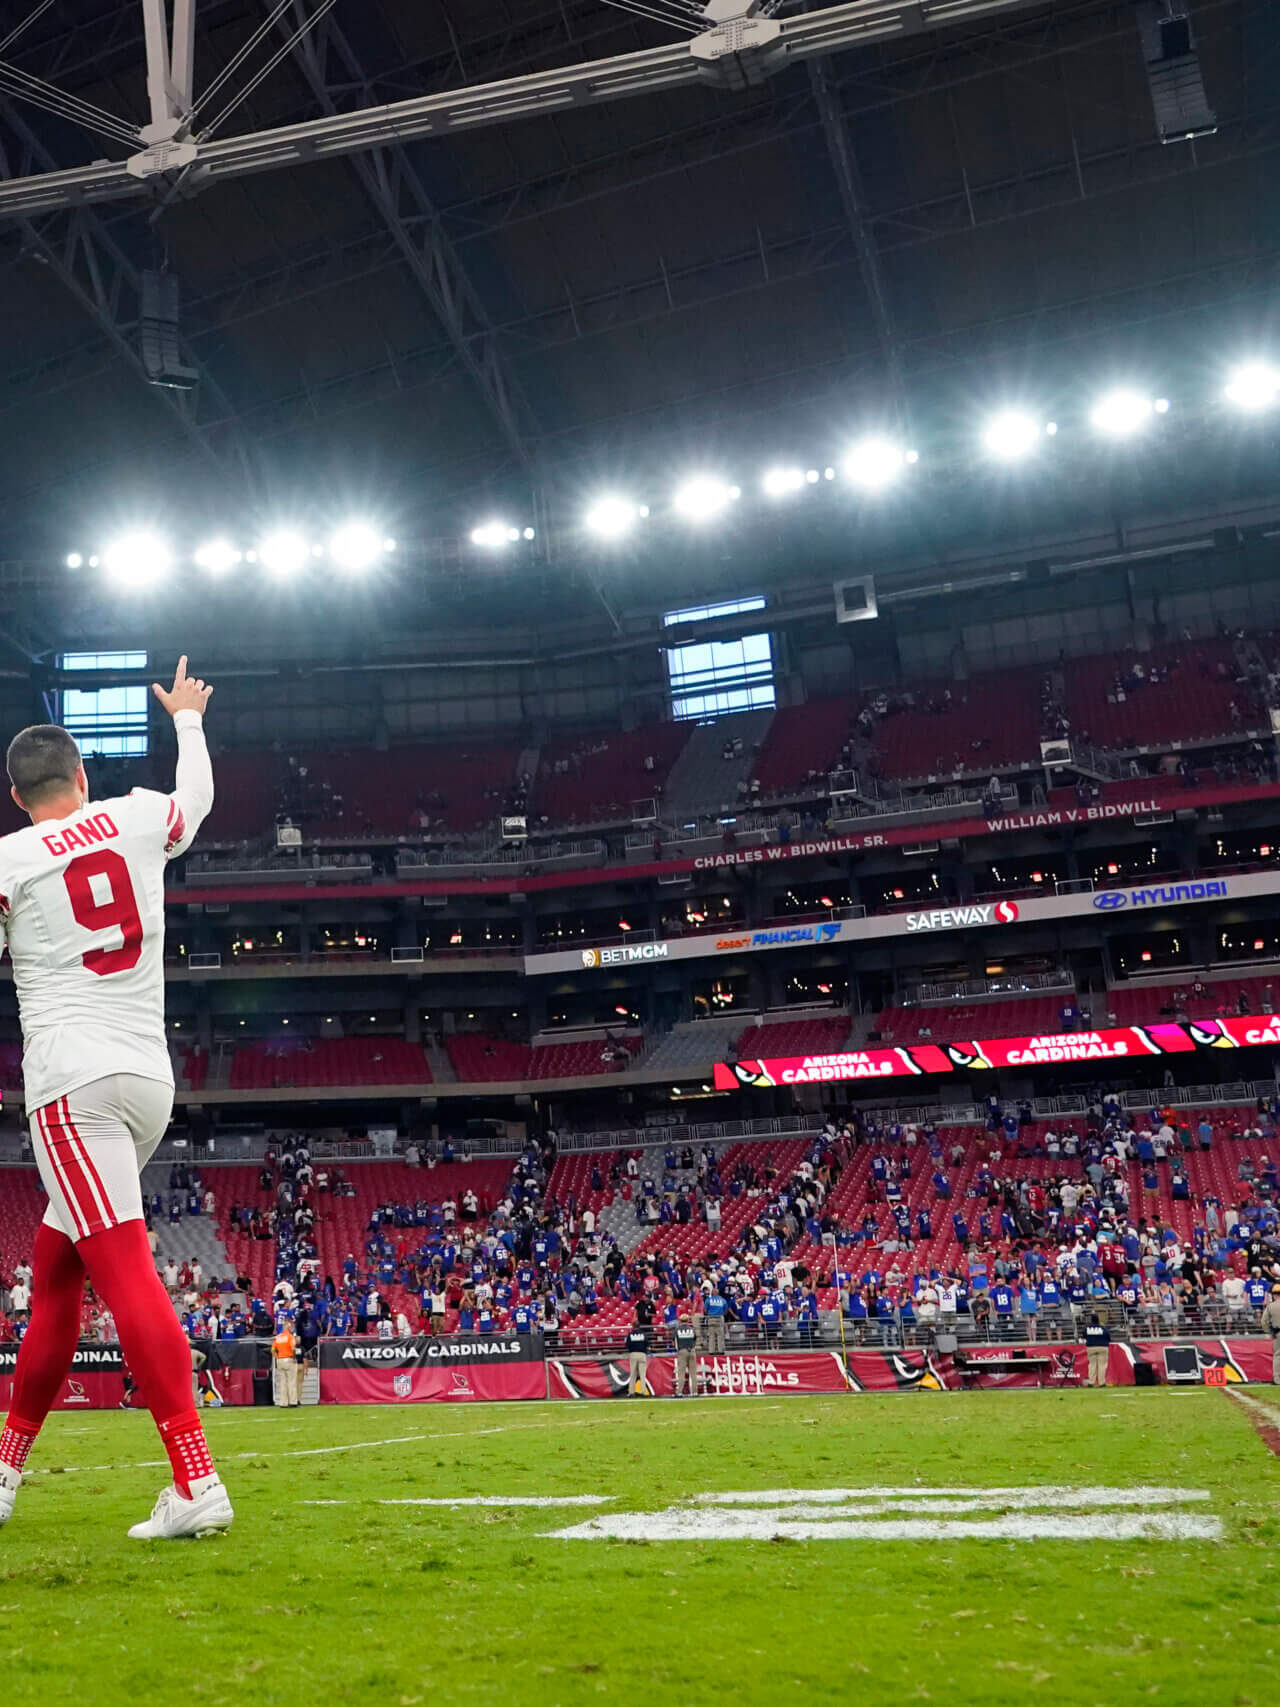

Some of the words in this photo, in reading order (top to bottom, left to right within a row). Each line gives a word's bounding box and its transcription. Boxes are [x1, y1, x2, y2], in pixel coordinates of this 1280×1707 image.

[987, 812, 1061, 832] WILLIAM
[1066, 810, 1083, 821] V.
[1087, 800, 1161, 819] BIDWILL
[41, 812, 120, 857] GANO
[694, 850, 763, 868] CHARLES
[767, 847, 786, 858] W.
[790, 838, 860, 857] BIDWILL,
[864, 835, 889, 847] SR.
[1132, 881, 1227, 906] HYUNDAI
[62, 848, 144, 977] 9
[906, 906, 992, 932] SAFEWAY
[752, 928, 814, 946] FINANCIAL
[600, 943, 669, 964] BETMGM
[1029, 1033, 1102, 1049] ARIZONA
[803, 1052, 870, 1068] ARIZONA
[1007, 1041, 1128, 1064] CARDINALS
[781, 1061, 894, 1083] CARDINALS
[341, 1347, 420, 1360] ARIZONA
[428, 1341, 521, 1358] CARDINALS
[1206, 1369, 1224, 1384] 20
